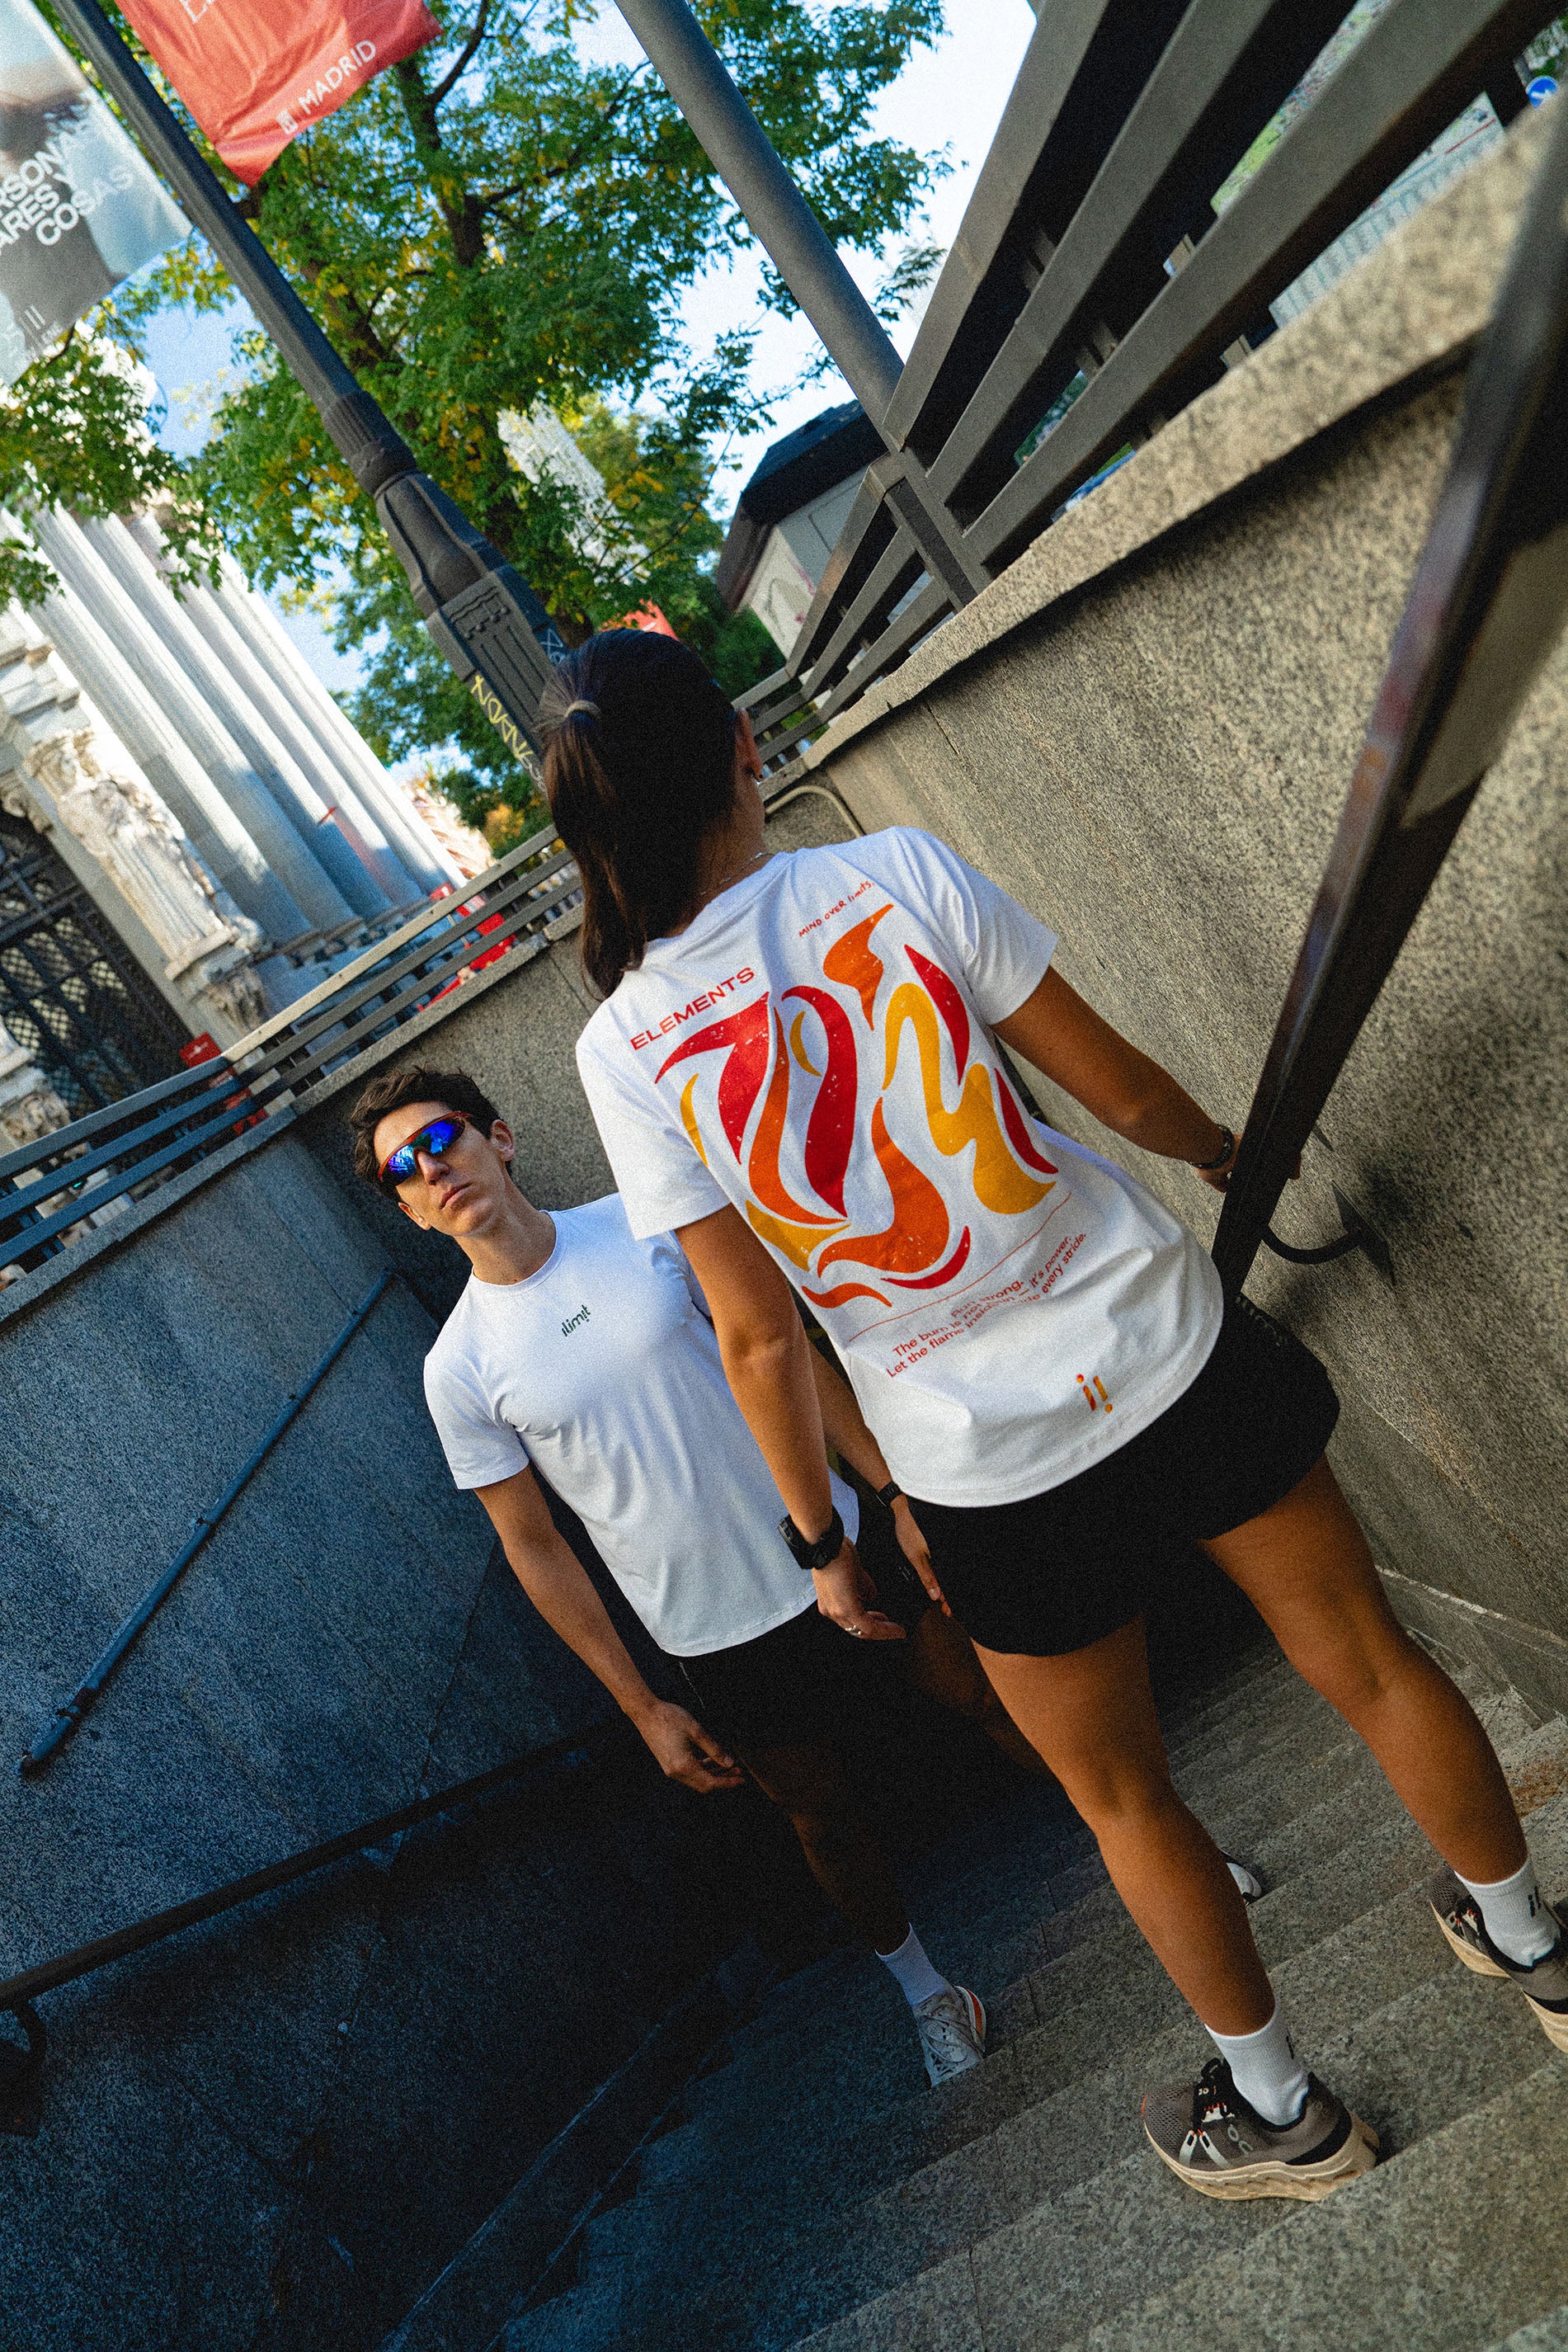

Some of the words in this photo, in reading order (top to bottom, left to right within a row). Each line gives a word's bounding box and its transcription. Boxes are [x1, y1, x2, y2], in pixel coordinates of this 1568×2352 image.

[298, 40, 376, 115] MADRID
[35, 166, 133, 246] COSAS
[798, 919, 822, 936] MIND
[825, 900, 847, 920] OVER
[629, 967, 755, 1050] ELEMENTS
[887, 1361, 907, 1377] Let
[907, 1347, 928, 1363] the
[929, 1329, 964, 1349] flame
[1042, 1264, 1064, 1294] every
[1062, 1233, 1086, 1264] stride.
[892, 1339, 917, 1356] The
[918, 1327, 949, 1341] burn
[1045, 1236, 1071, 1273] power.
